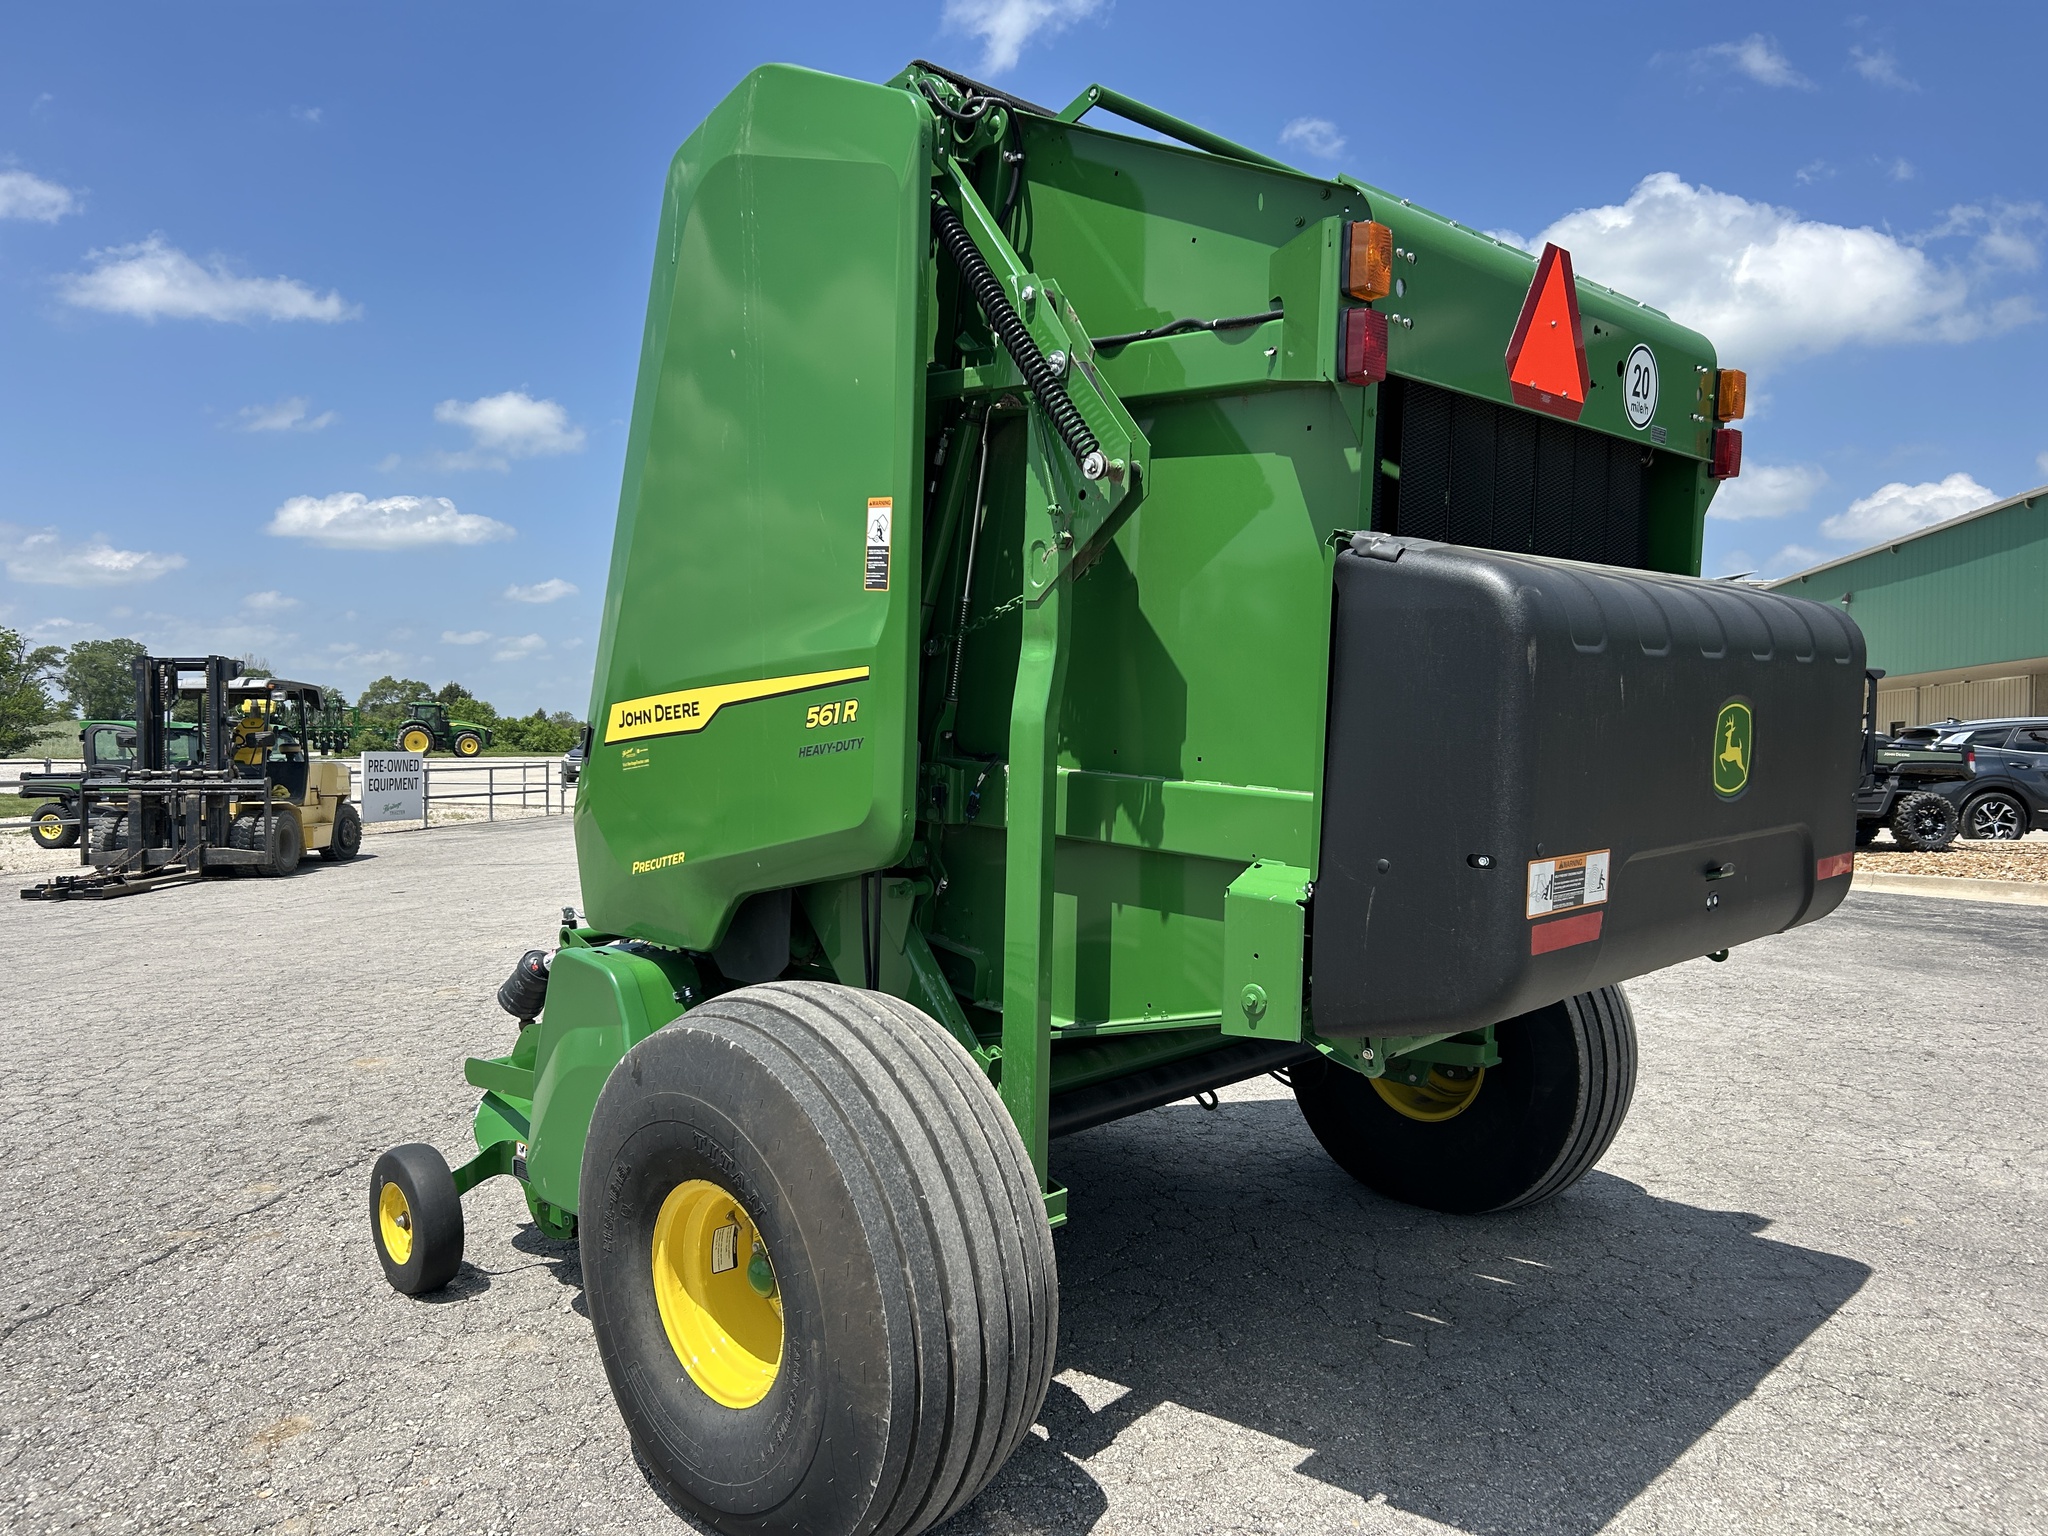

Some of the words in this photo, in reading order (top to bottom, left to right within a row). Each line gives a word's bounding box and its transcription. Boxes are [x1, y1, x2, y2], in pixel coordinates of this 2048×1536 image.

[1632, 364, 1650, 400] 20
[619, 709, 652, 728] JOHN
[654, 701, 700, 722] DEERE
[798, 737, 864, 758] HEAVY-DUTY
[368, 759, 420, 773] PRE-OWNED
[368, 777, 419, 793] EQUIPMENT
[632, 851, 685, 875] PRECUTTER
[1563, 859, 1583, 868] WARNING
[693, 1129, 768, 1220] TITAN
